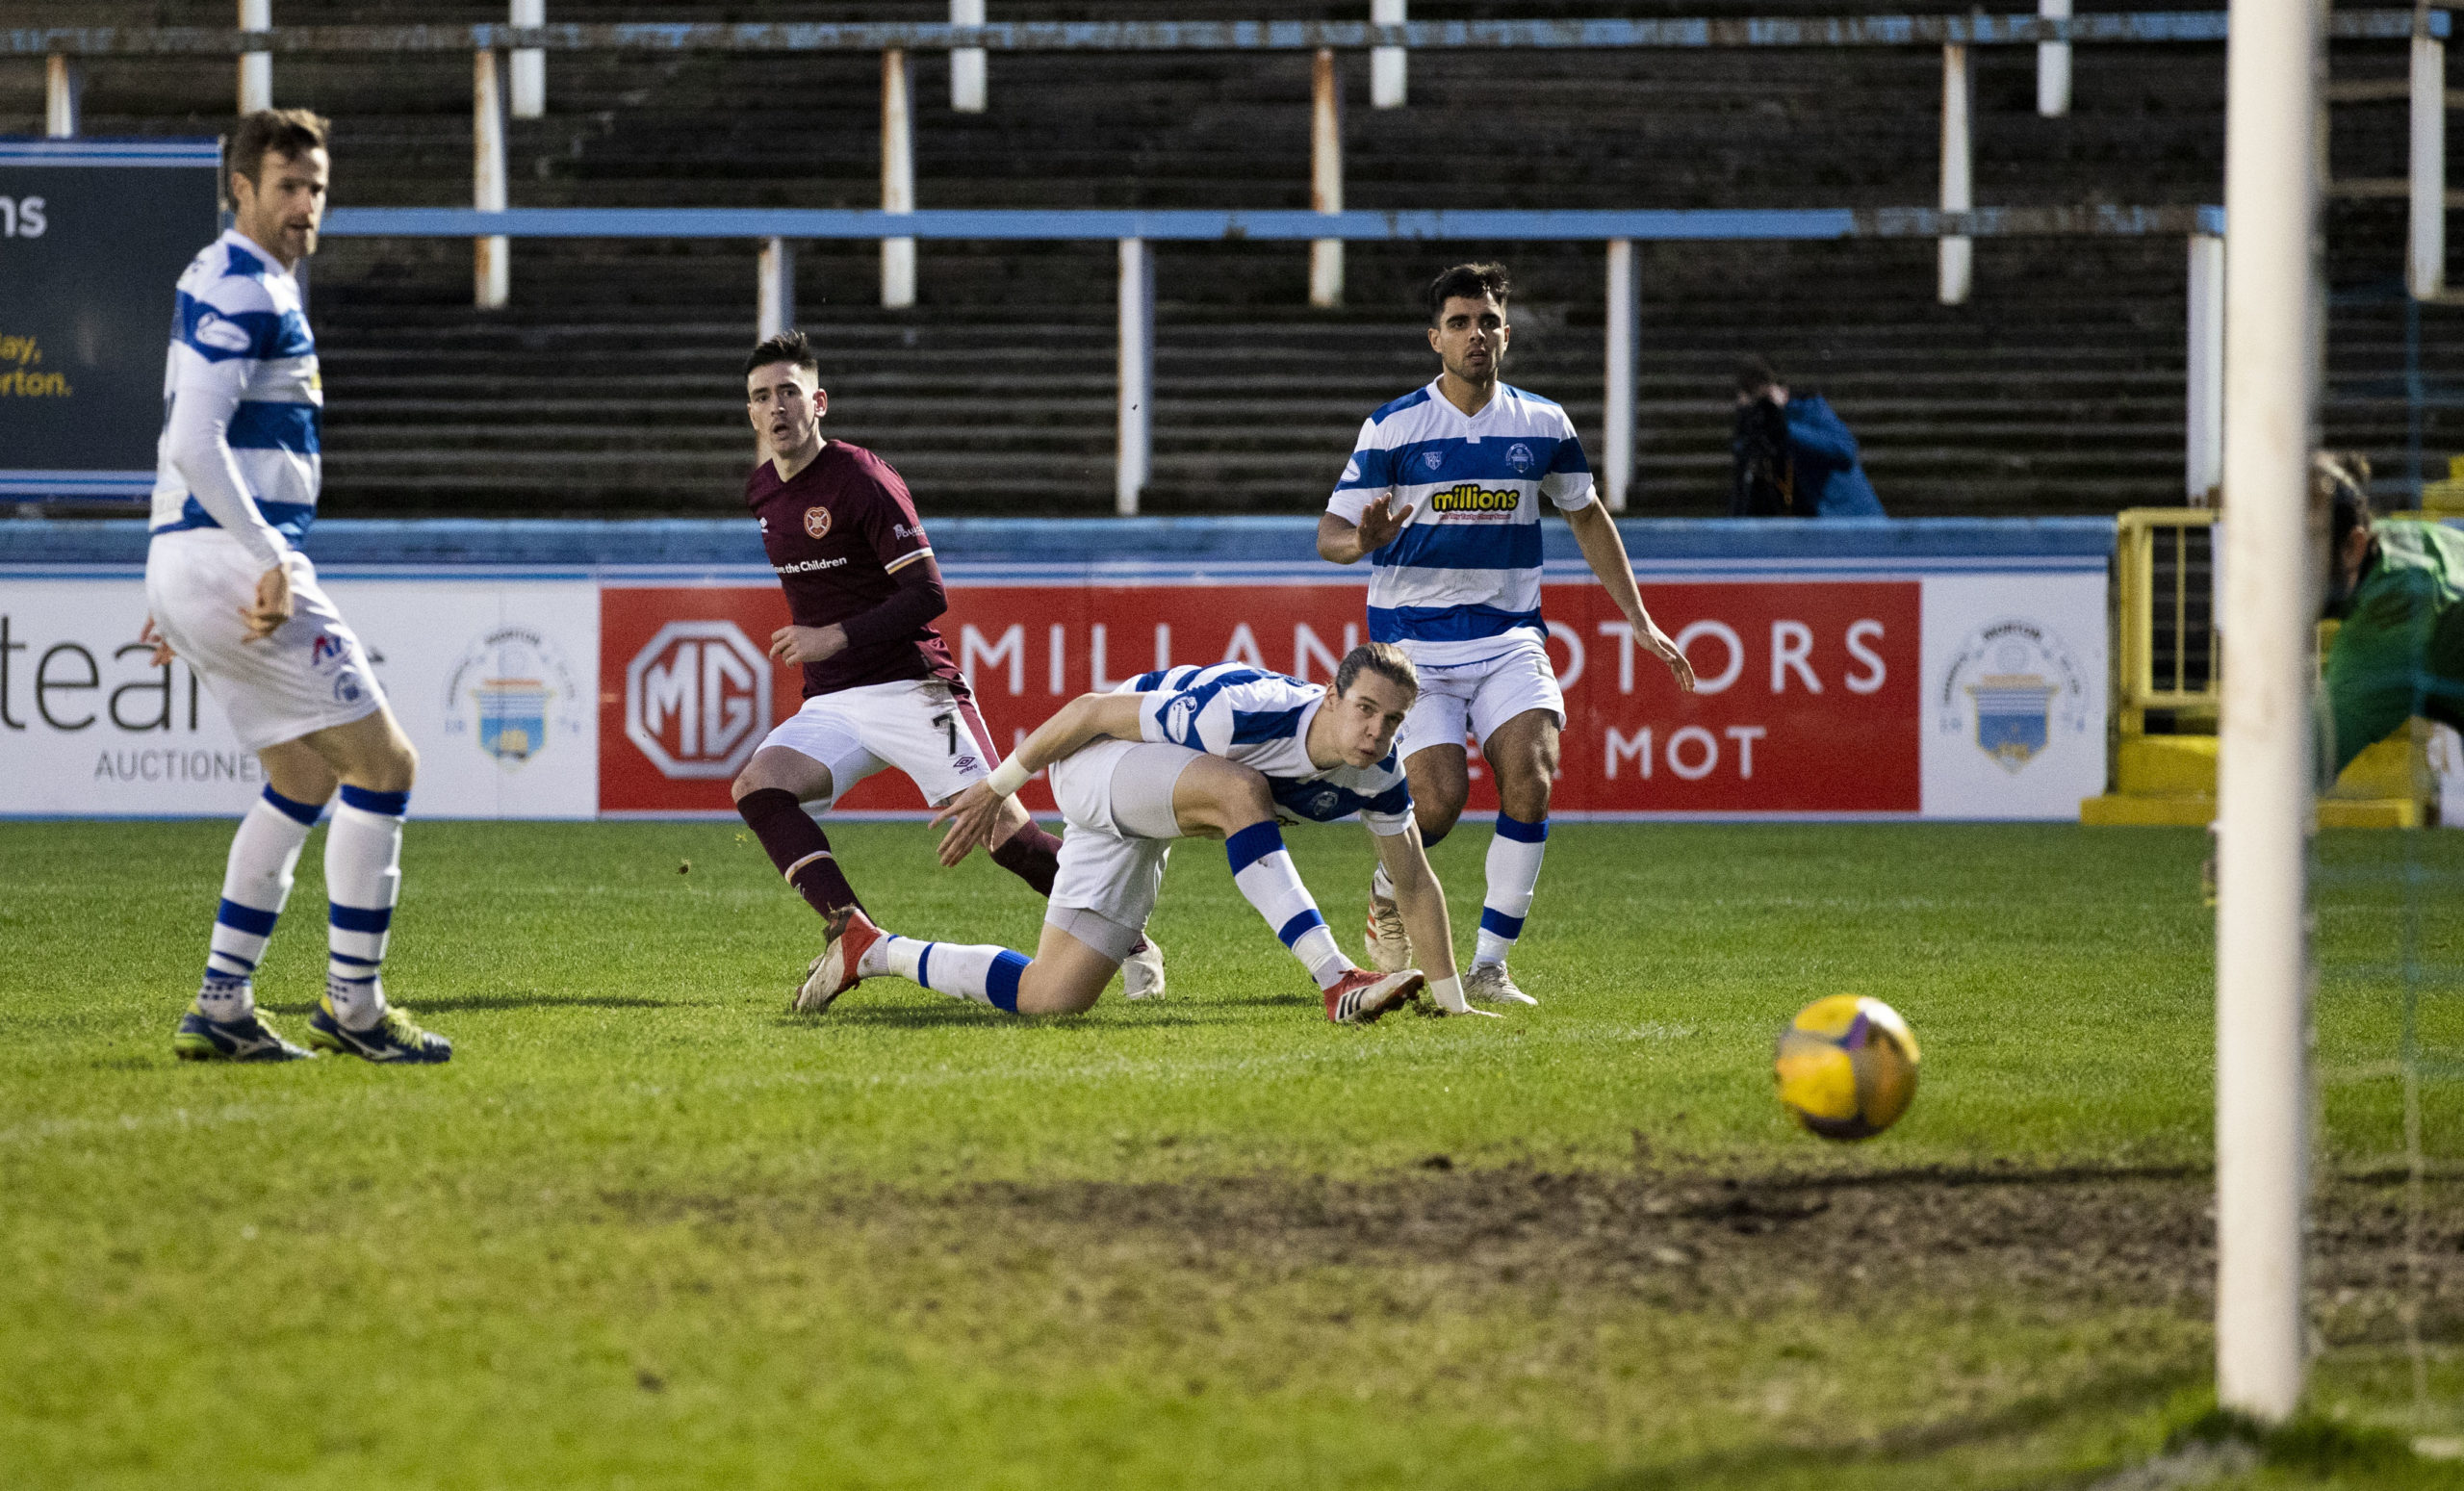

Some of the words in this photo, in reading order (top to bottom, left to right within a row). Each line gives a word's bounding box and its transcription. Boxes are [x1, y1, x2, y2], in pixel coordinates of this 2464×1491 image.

[1432, 484, 1520, 512] millions
[785, 563, 800, 574] the
[800, 556, 847, 571] Children
[644, 638, 753, 758] MG
[933, 712, 957, 756] 7
[94, 748, 270, 783] AUCTIONE
[959, 764, 978, 775] umbro
[1604, 725, 1766, 781] MOT
